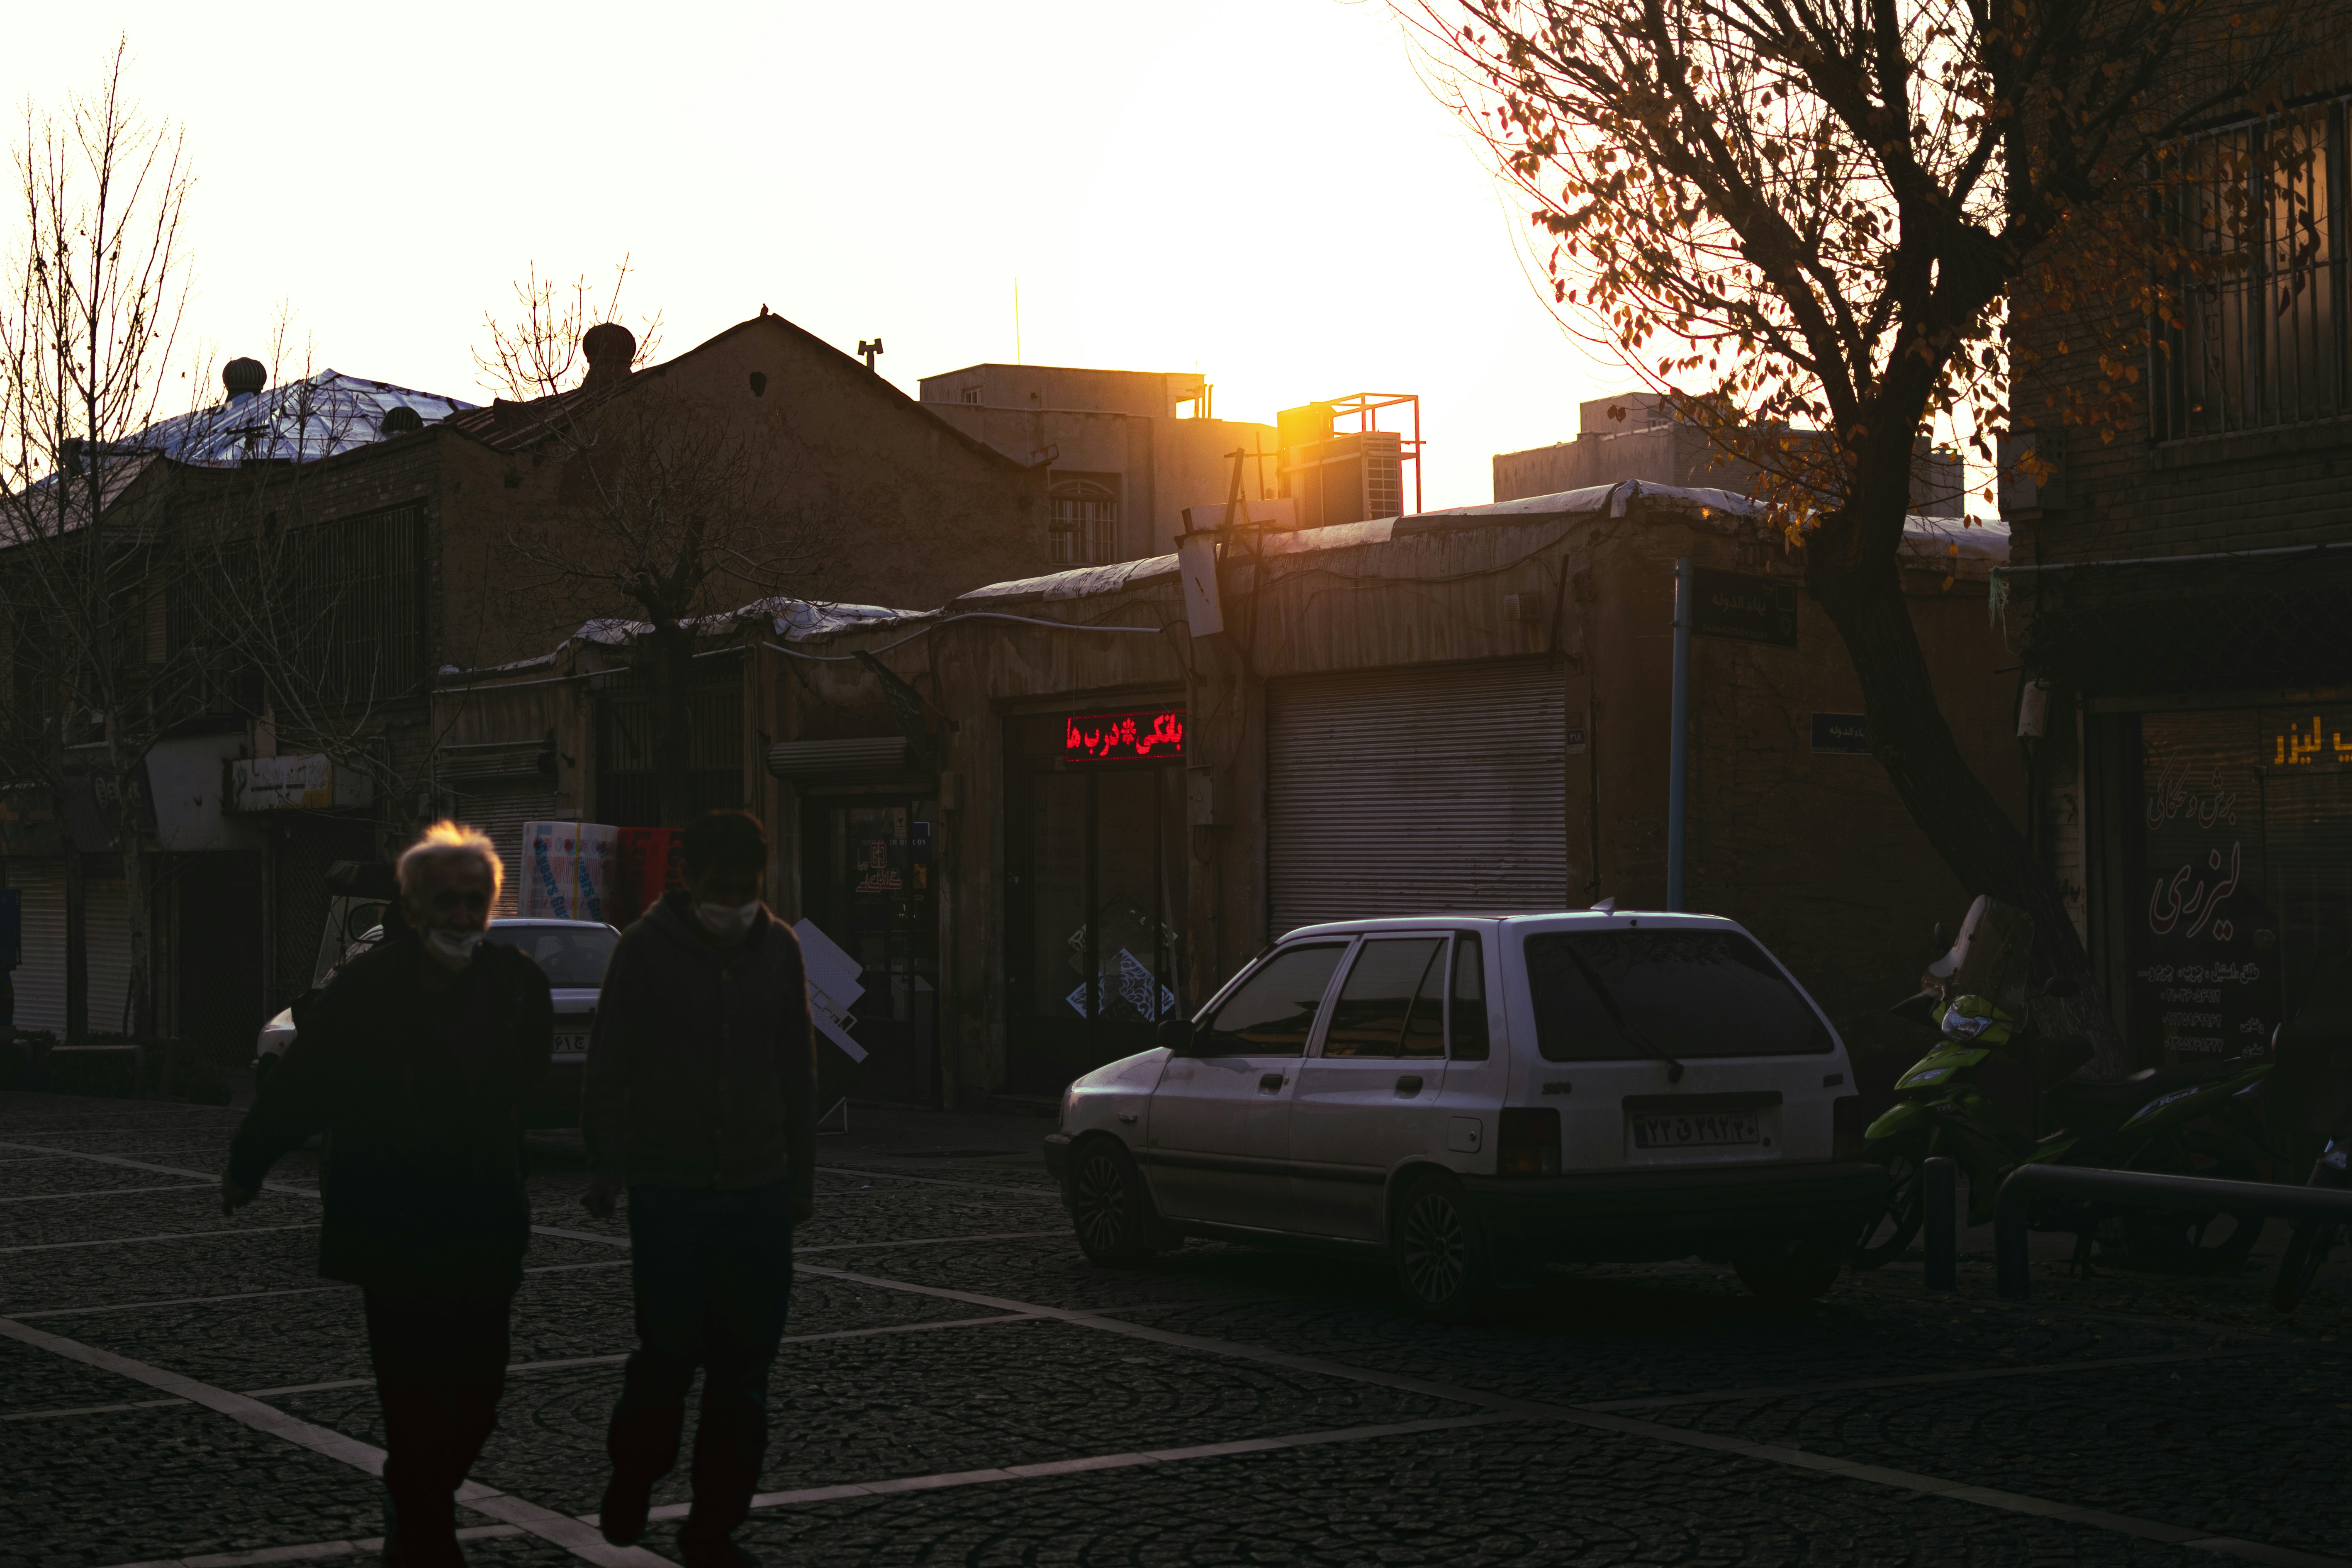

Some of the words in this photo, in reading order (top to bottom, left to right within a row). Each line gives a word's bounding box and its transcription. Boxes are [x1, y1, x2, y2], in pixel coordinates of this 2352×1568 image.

[1712, 592, 1744, 613] الدوله
[1750, 631, 1768, 640] ALLEY
[1542, 1081, 1572, 1096] SAIPA
[1936, 1103, 1951, 1112] TVS
